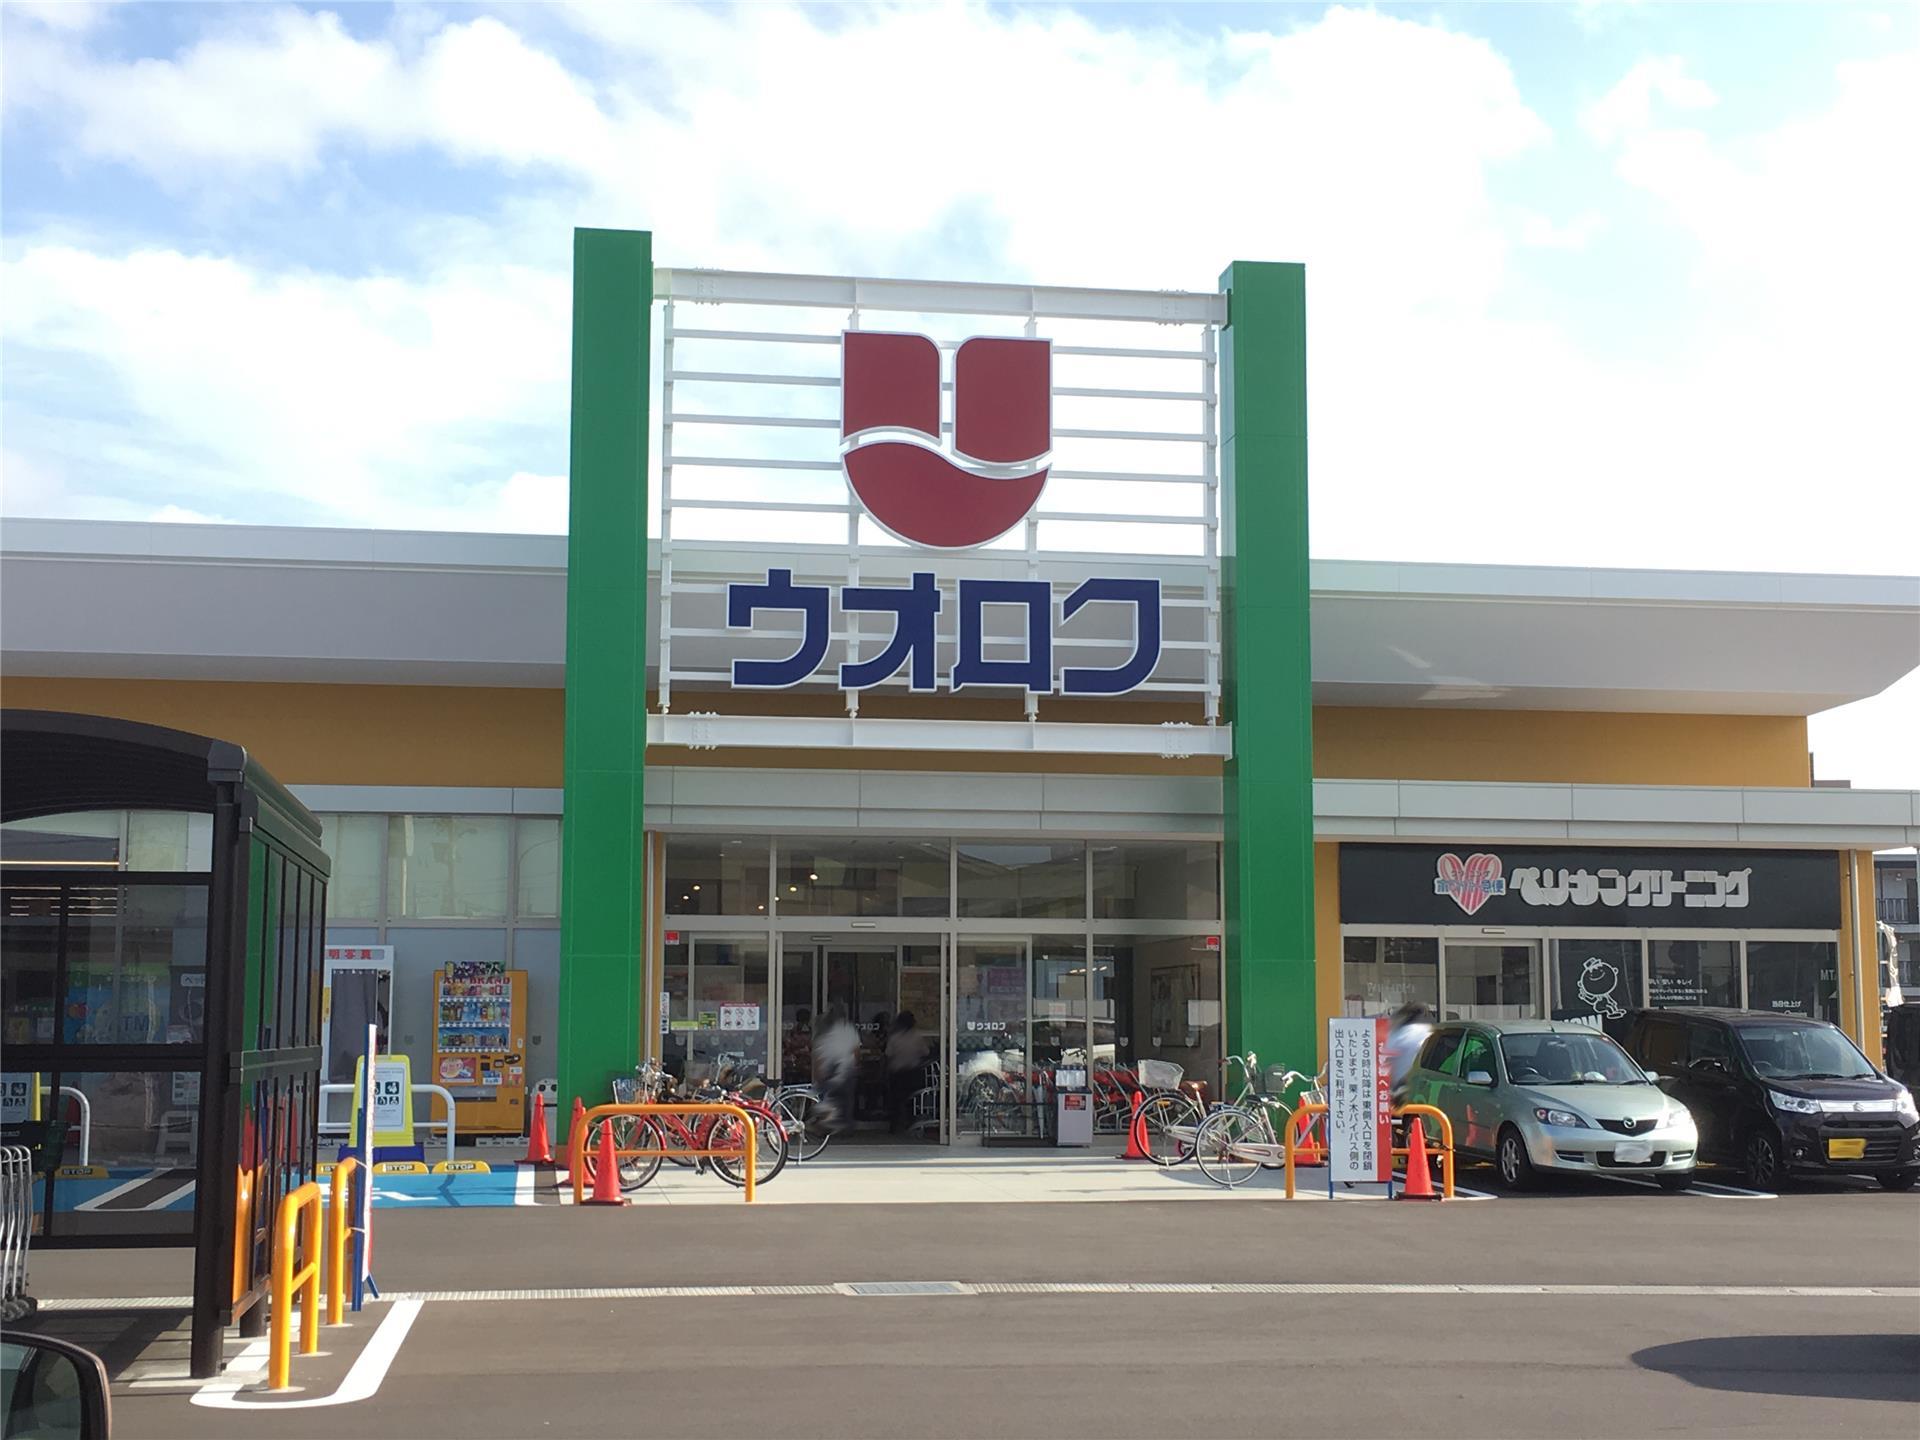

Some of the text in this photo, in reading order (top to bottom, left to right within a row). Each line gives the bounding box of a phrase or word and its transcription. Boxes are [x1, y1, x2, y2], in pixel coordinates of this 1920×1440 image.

[727, 569, 1162, 696] ウオロク
[1509, 866, 1752, 907] ペリカンクリーニング
[447, 1163, 475, 1171] STOP
